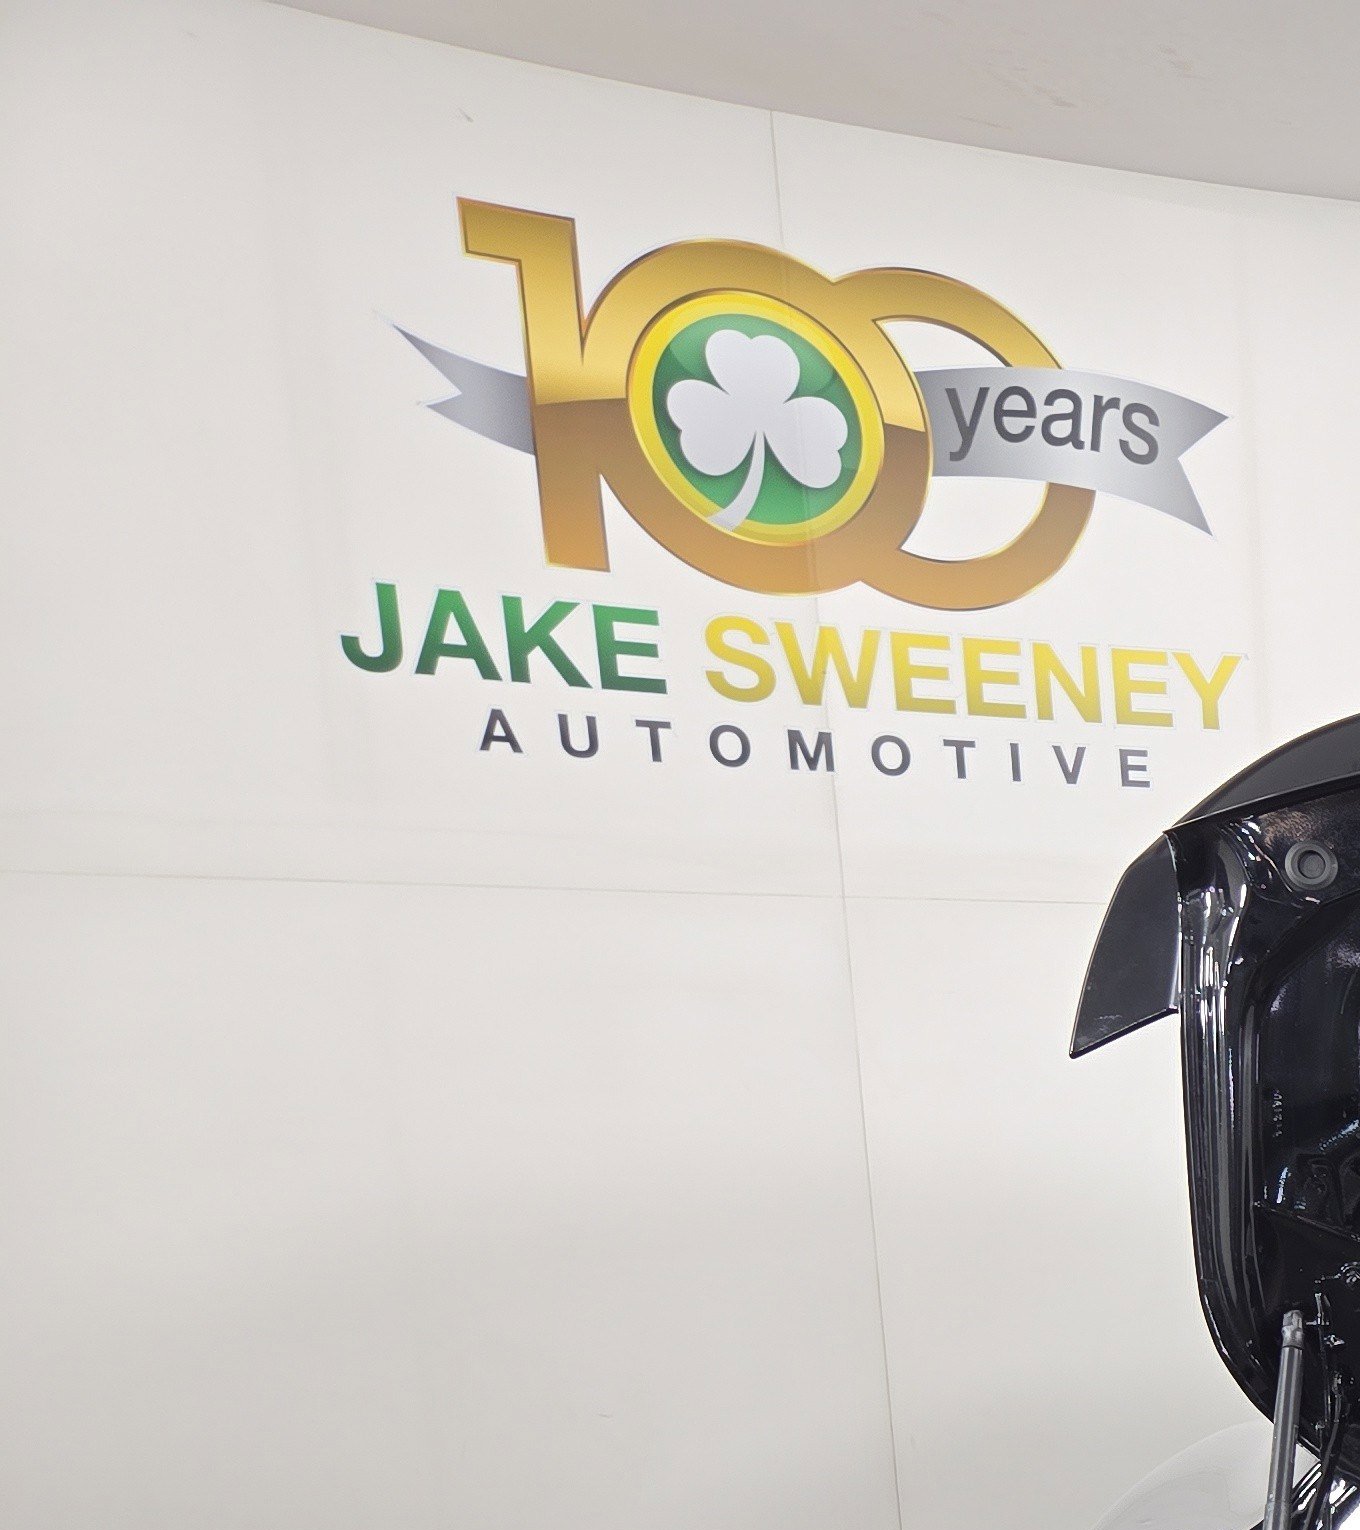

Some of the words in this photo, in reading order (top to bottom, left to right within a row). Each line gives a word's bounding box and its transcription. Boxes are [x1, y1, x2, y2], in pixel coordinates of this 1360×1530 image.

[944, 384, 1161, 465] years
[340, 581, 668, 695] JAKE
[704, 615, 1242, 731] SWEENEY
[479, 708, 1152, 789] AUTOMOTIVE
